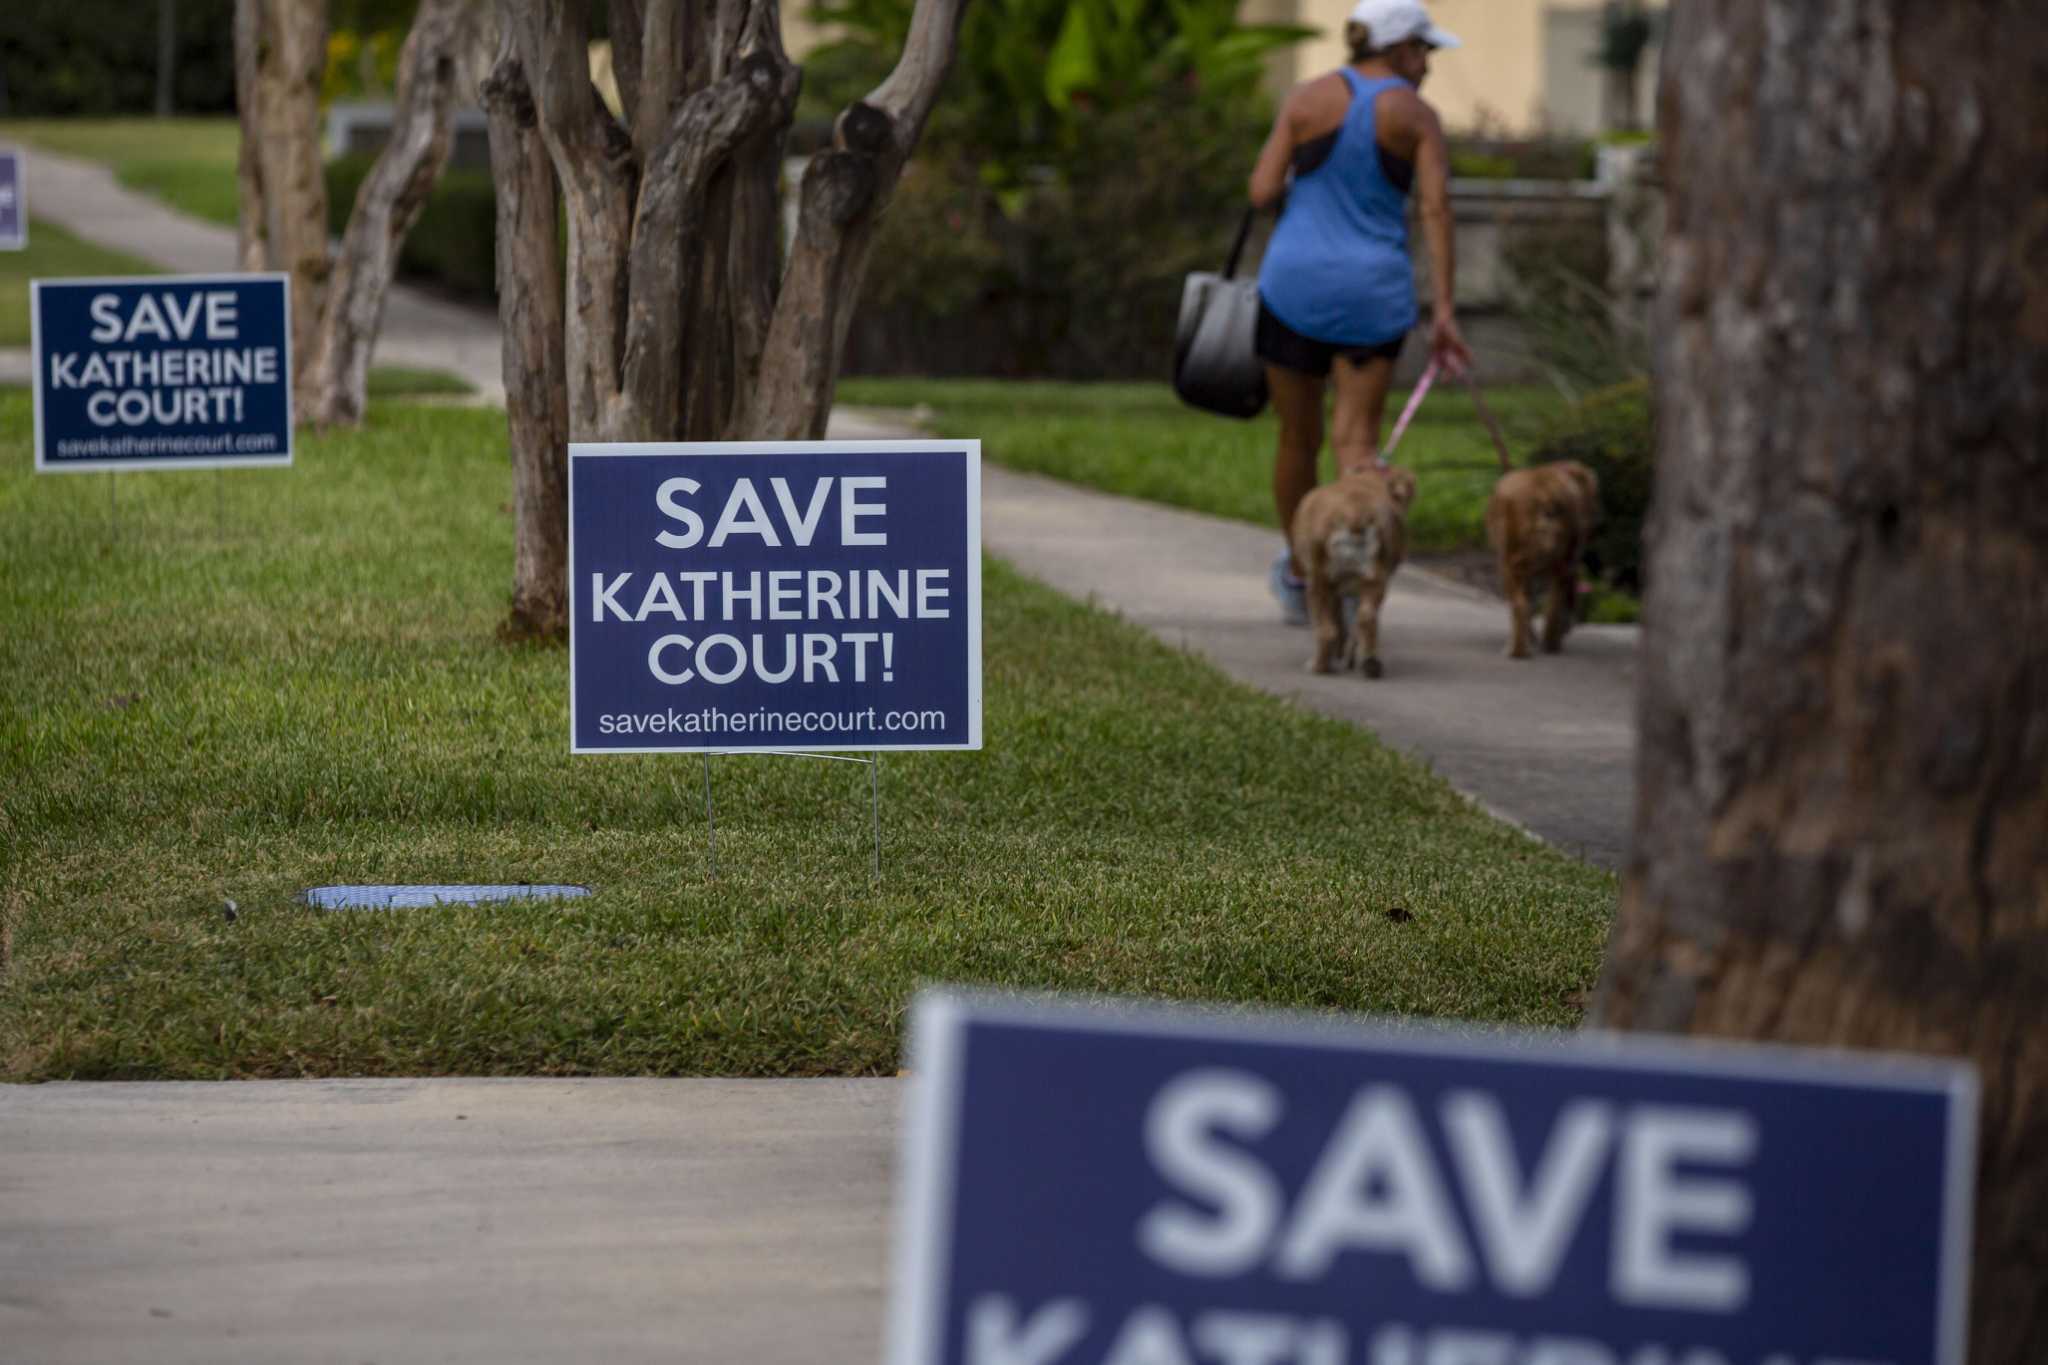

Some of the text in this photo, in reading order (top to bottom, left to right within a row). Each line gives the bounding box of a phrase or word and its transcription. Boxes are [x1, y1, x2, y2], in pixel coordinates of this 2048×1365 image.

[89, 291, 239, 343] SAVE
[50, 347, 279, 389] KATHERINE
[86, 386, 244, 426] COURT!
[57, 432, 277, 457] savekatherinecourt.com
[655, 476, 888, 549] SAVE
[591, 568, 950, 622] KATHERINE
[647, 632, 894, 685] COURT!
[599, 706, 946, 734] savekatherinecourt.com
[1140, 1064, 1760, 1312] SAVE
